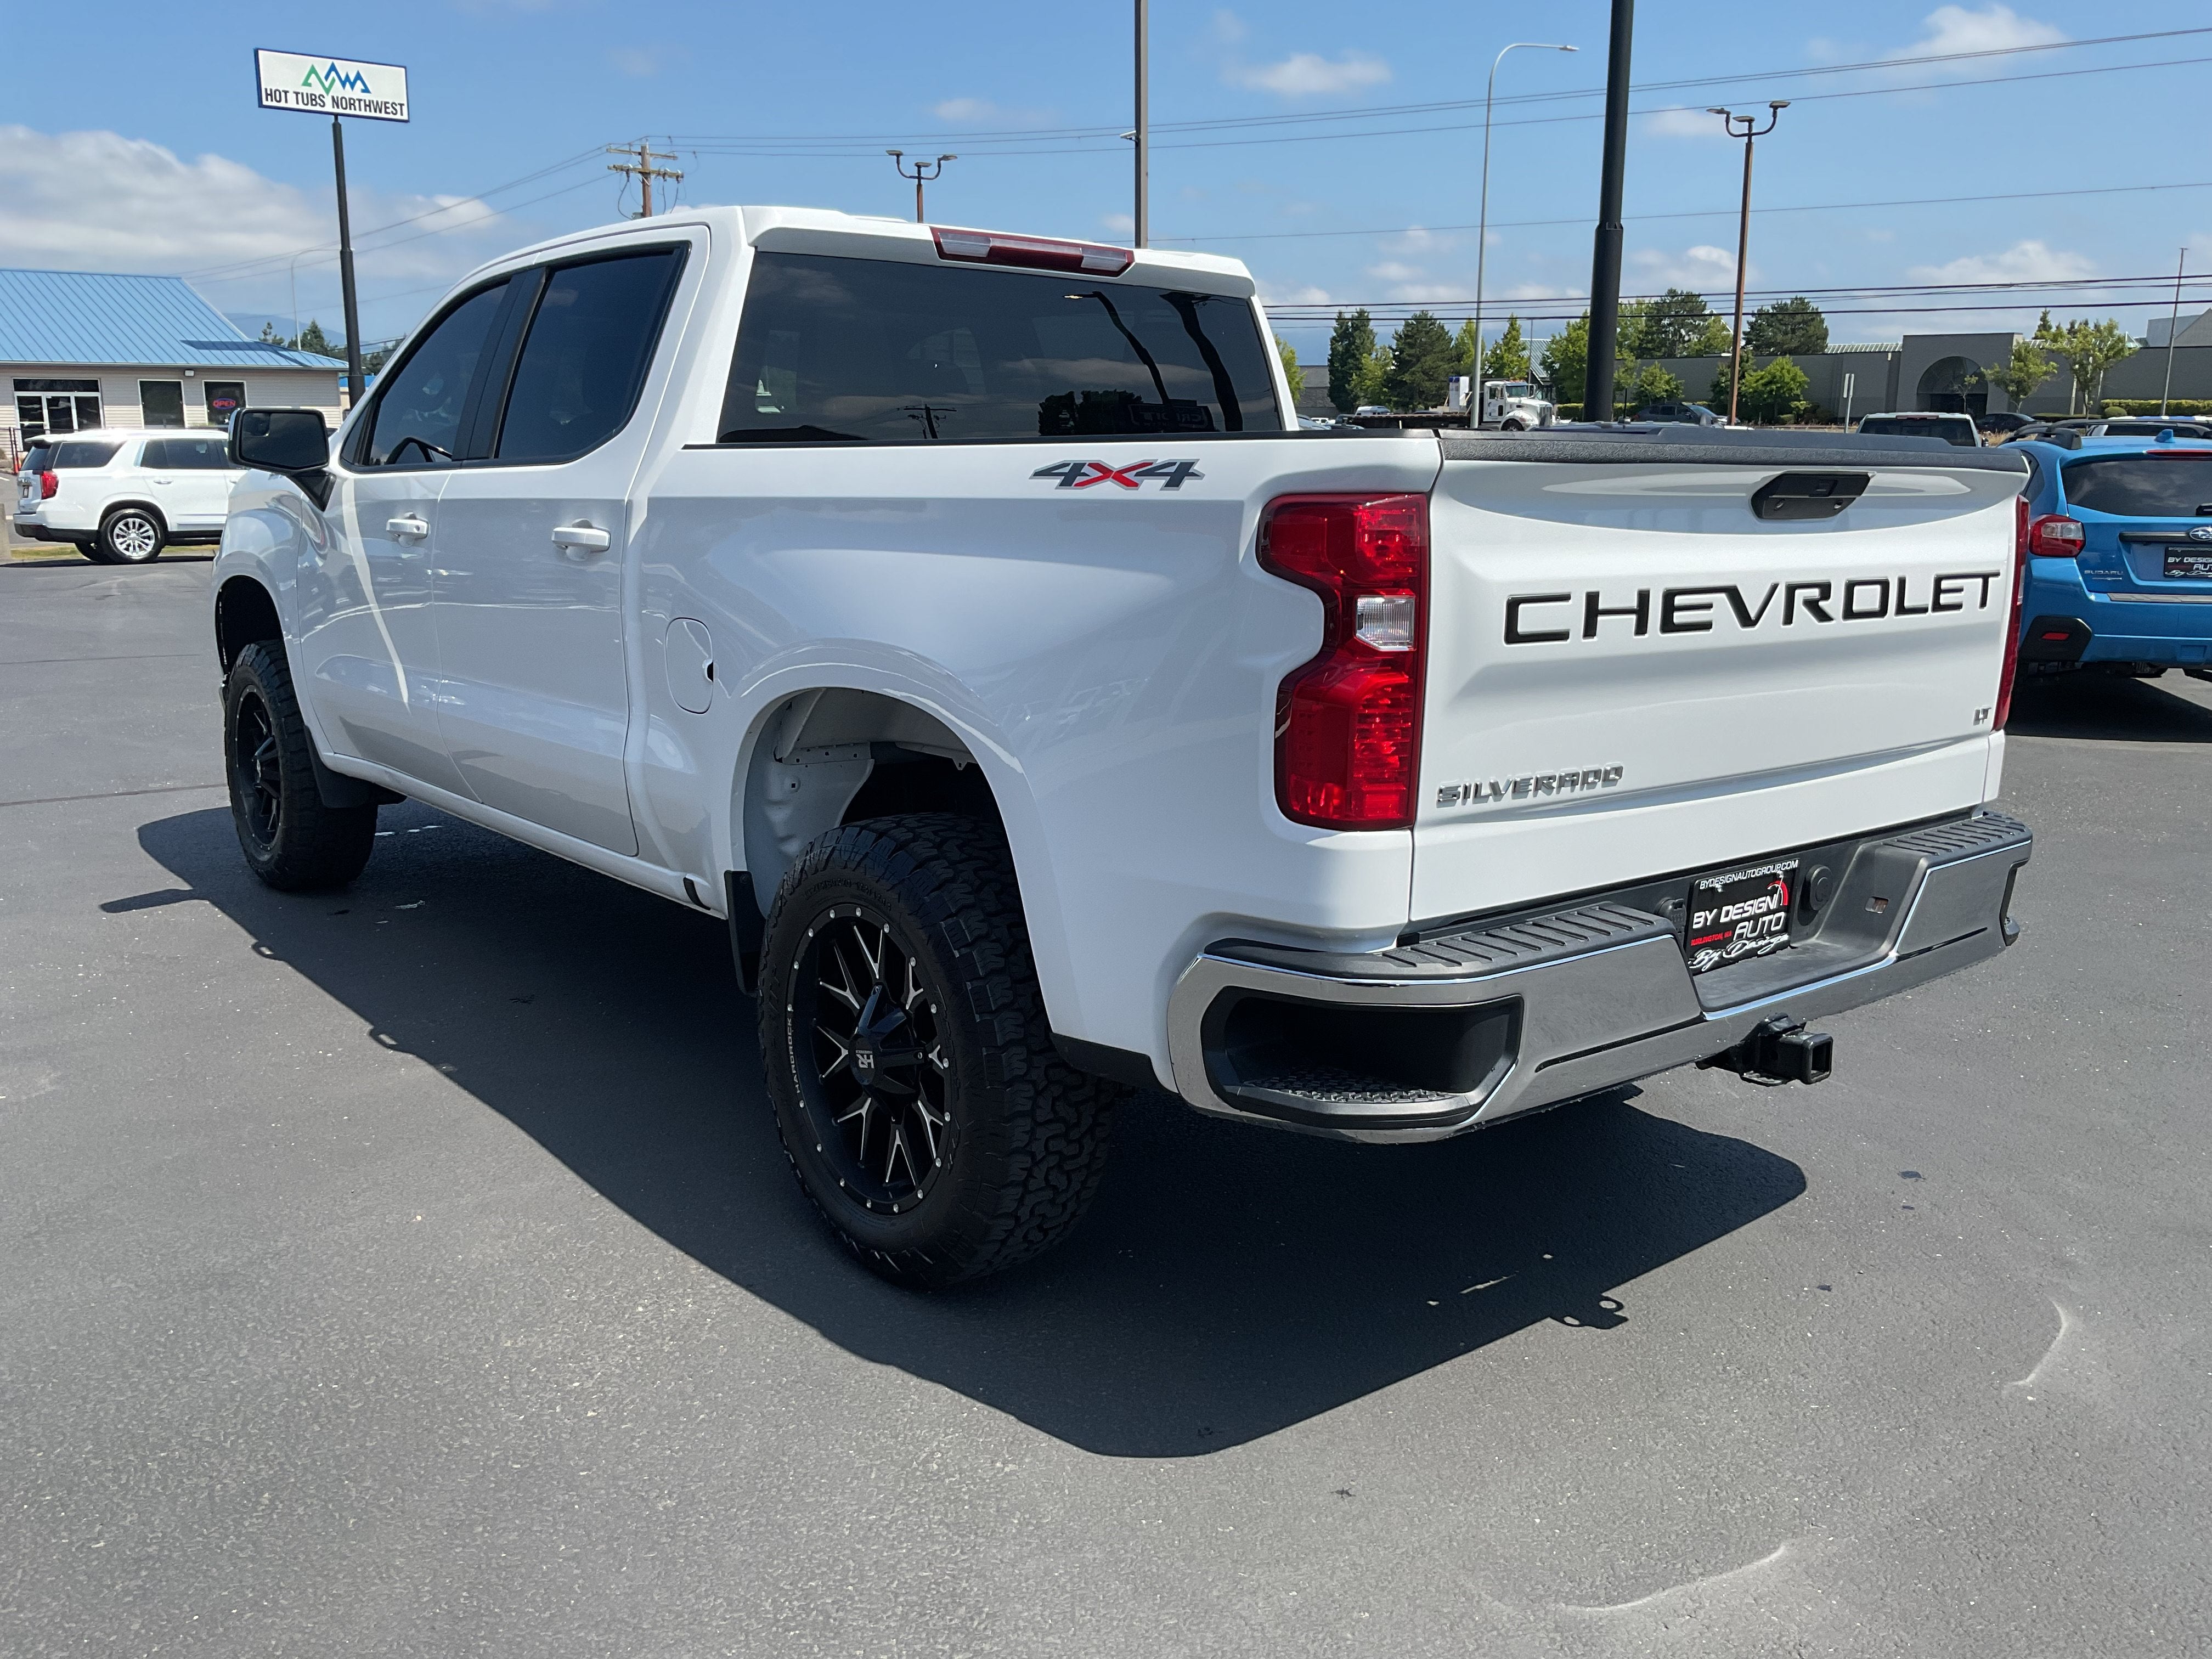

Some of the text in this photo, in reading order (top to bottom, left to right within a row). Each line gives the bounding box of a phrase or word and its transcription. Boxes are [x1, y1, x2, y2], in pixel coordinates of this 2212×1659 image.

[264, 88, 405, 116] HOT TUBS NORTHWEST
[1504, 571, 2000, 645] CHEVROLET
[1974, 707, 1991, 723] LT
[1436, 765, 1624, 805] SILVERADO
[1692, 894, 1778, 929] BY DESIGN
[1733, 911, 1785, 941] AUTO
[1688, 949, 1723, 972] By
[787, 1018, 800, 1093] HARDROCK
